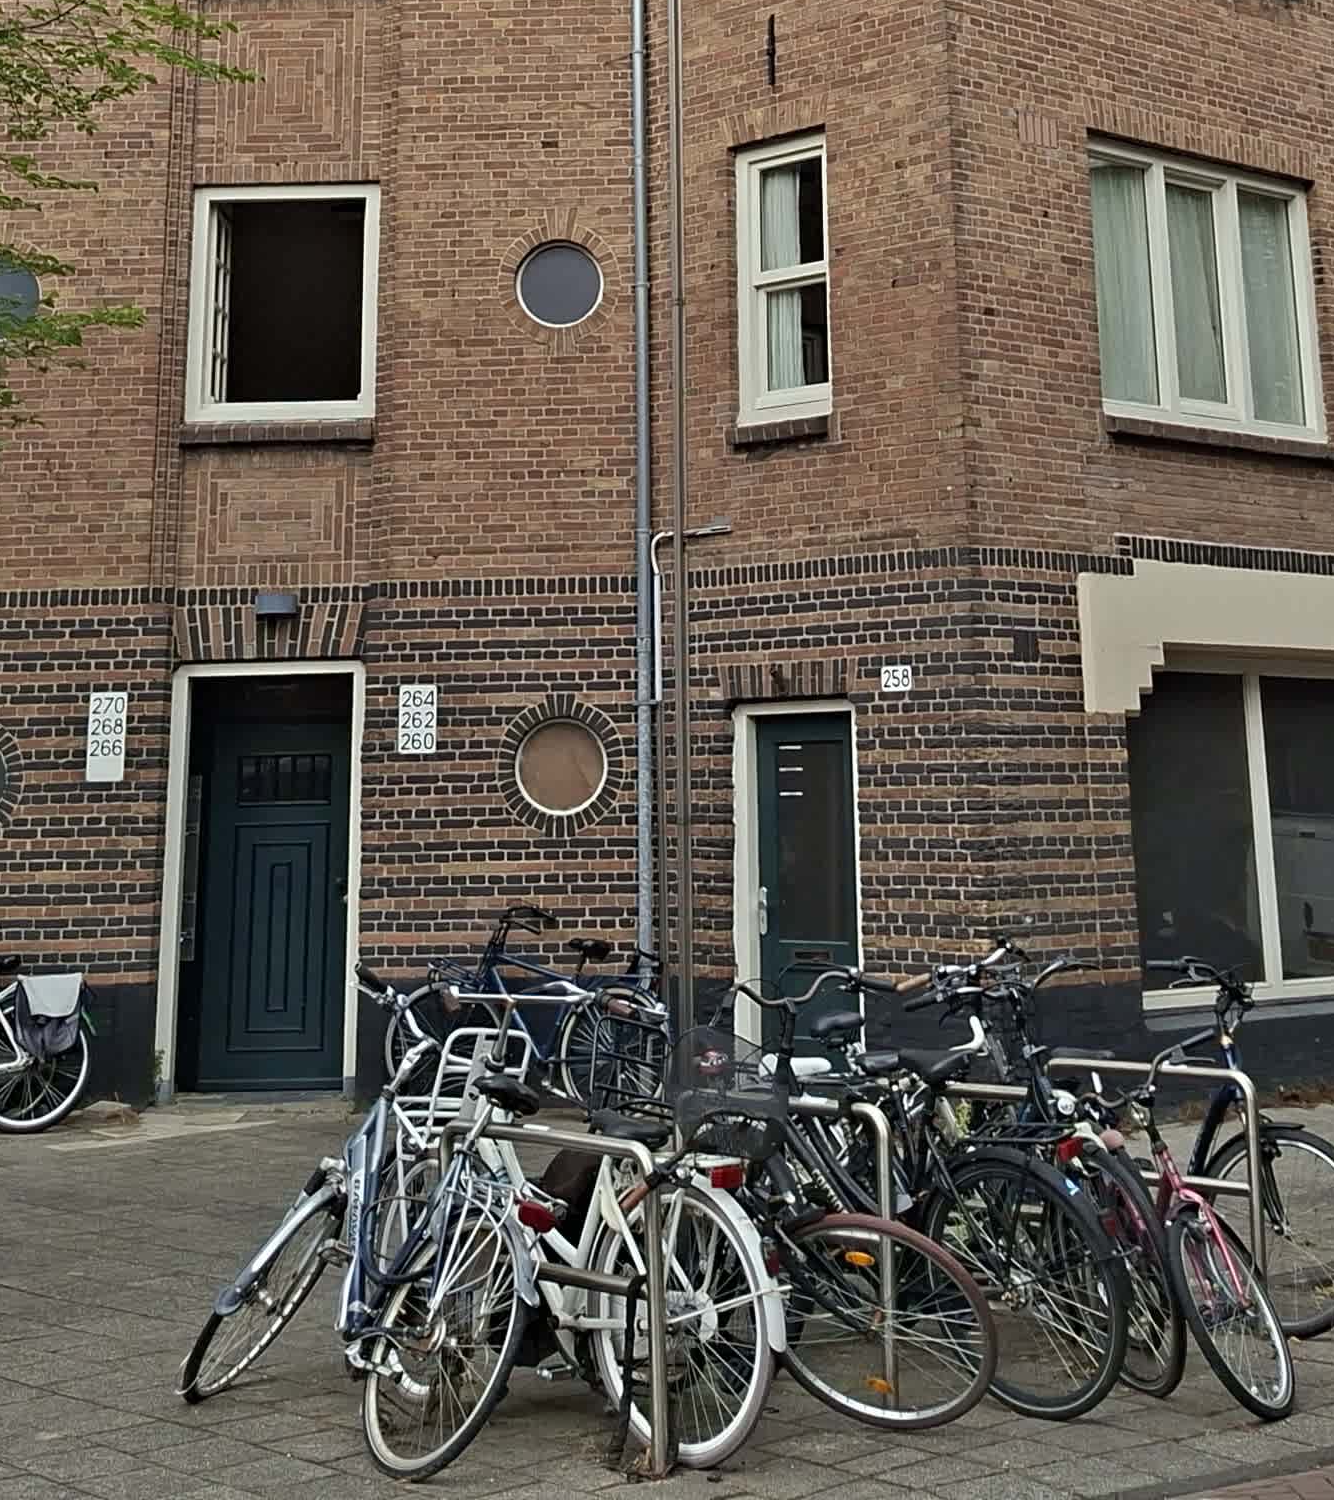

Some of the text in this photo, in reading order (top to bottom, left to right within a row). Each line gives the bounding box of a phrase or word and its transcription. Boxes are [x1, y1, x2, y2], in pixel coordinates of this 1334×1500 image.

[882, 668, 910, 689] 258
[91, 696, 125, 715] 270
[401, 690, 435, 708] 264
[90, 717, 124, 736] 268
[400, 711, 435, 729] 262
[89, 739, 123, 757] 266
[400, 732, 435, 750] 260
